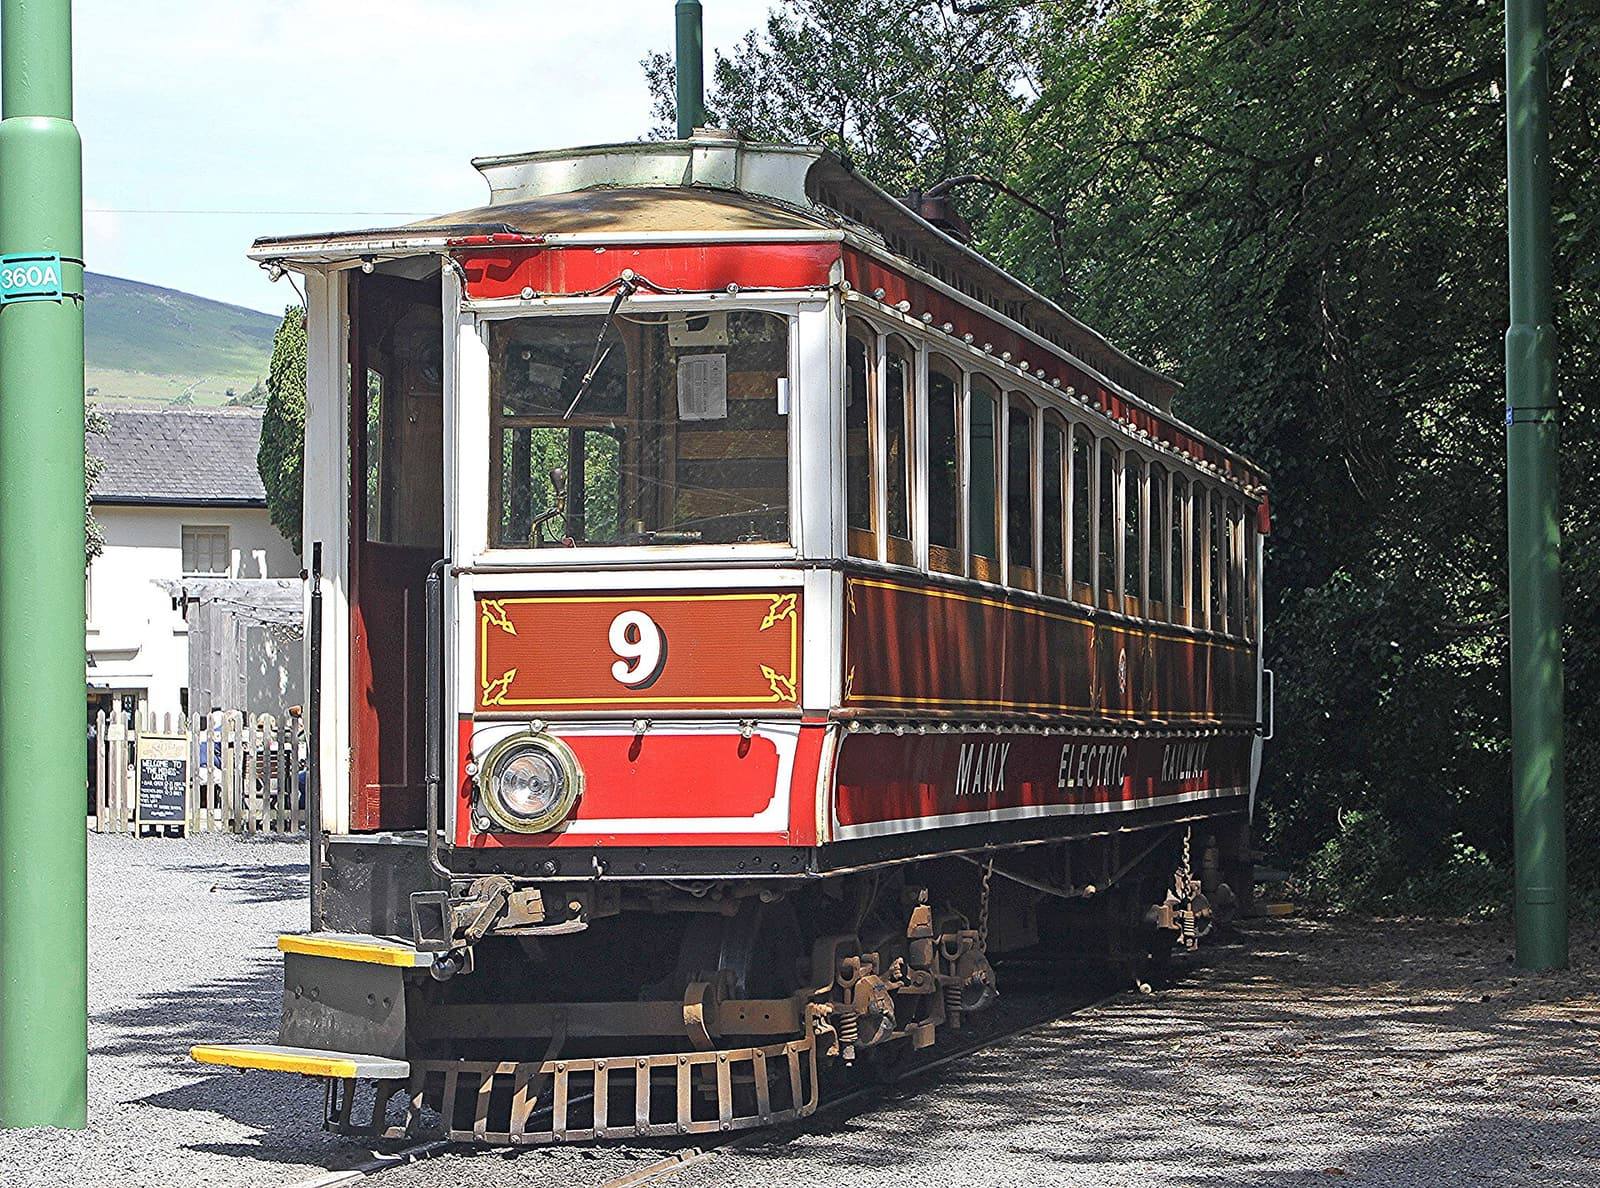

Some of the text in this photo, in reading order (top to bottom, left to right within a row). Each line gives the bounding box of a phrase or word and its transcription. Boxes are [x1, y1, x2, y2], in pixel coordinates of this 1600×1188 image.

[1, 266, 58, 289] 360A
[608, 609, 667, 689] 9
[955, 742, 1208, 795] MANX ELECTRIC RAILWAY
